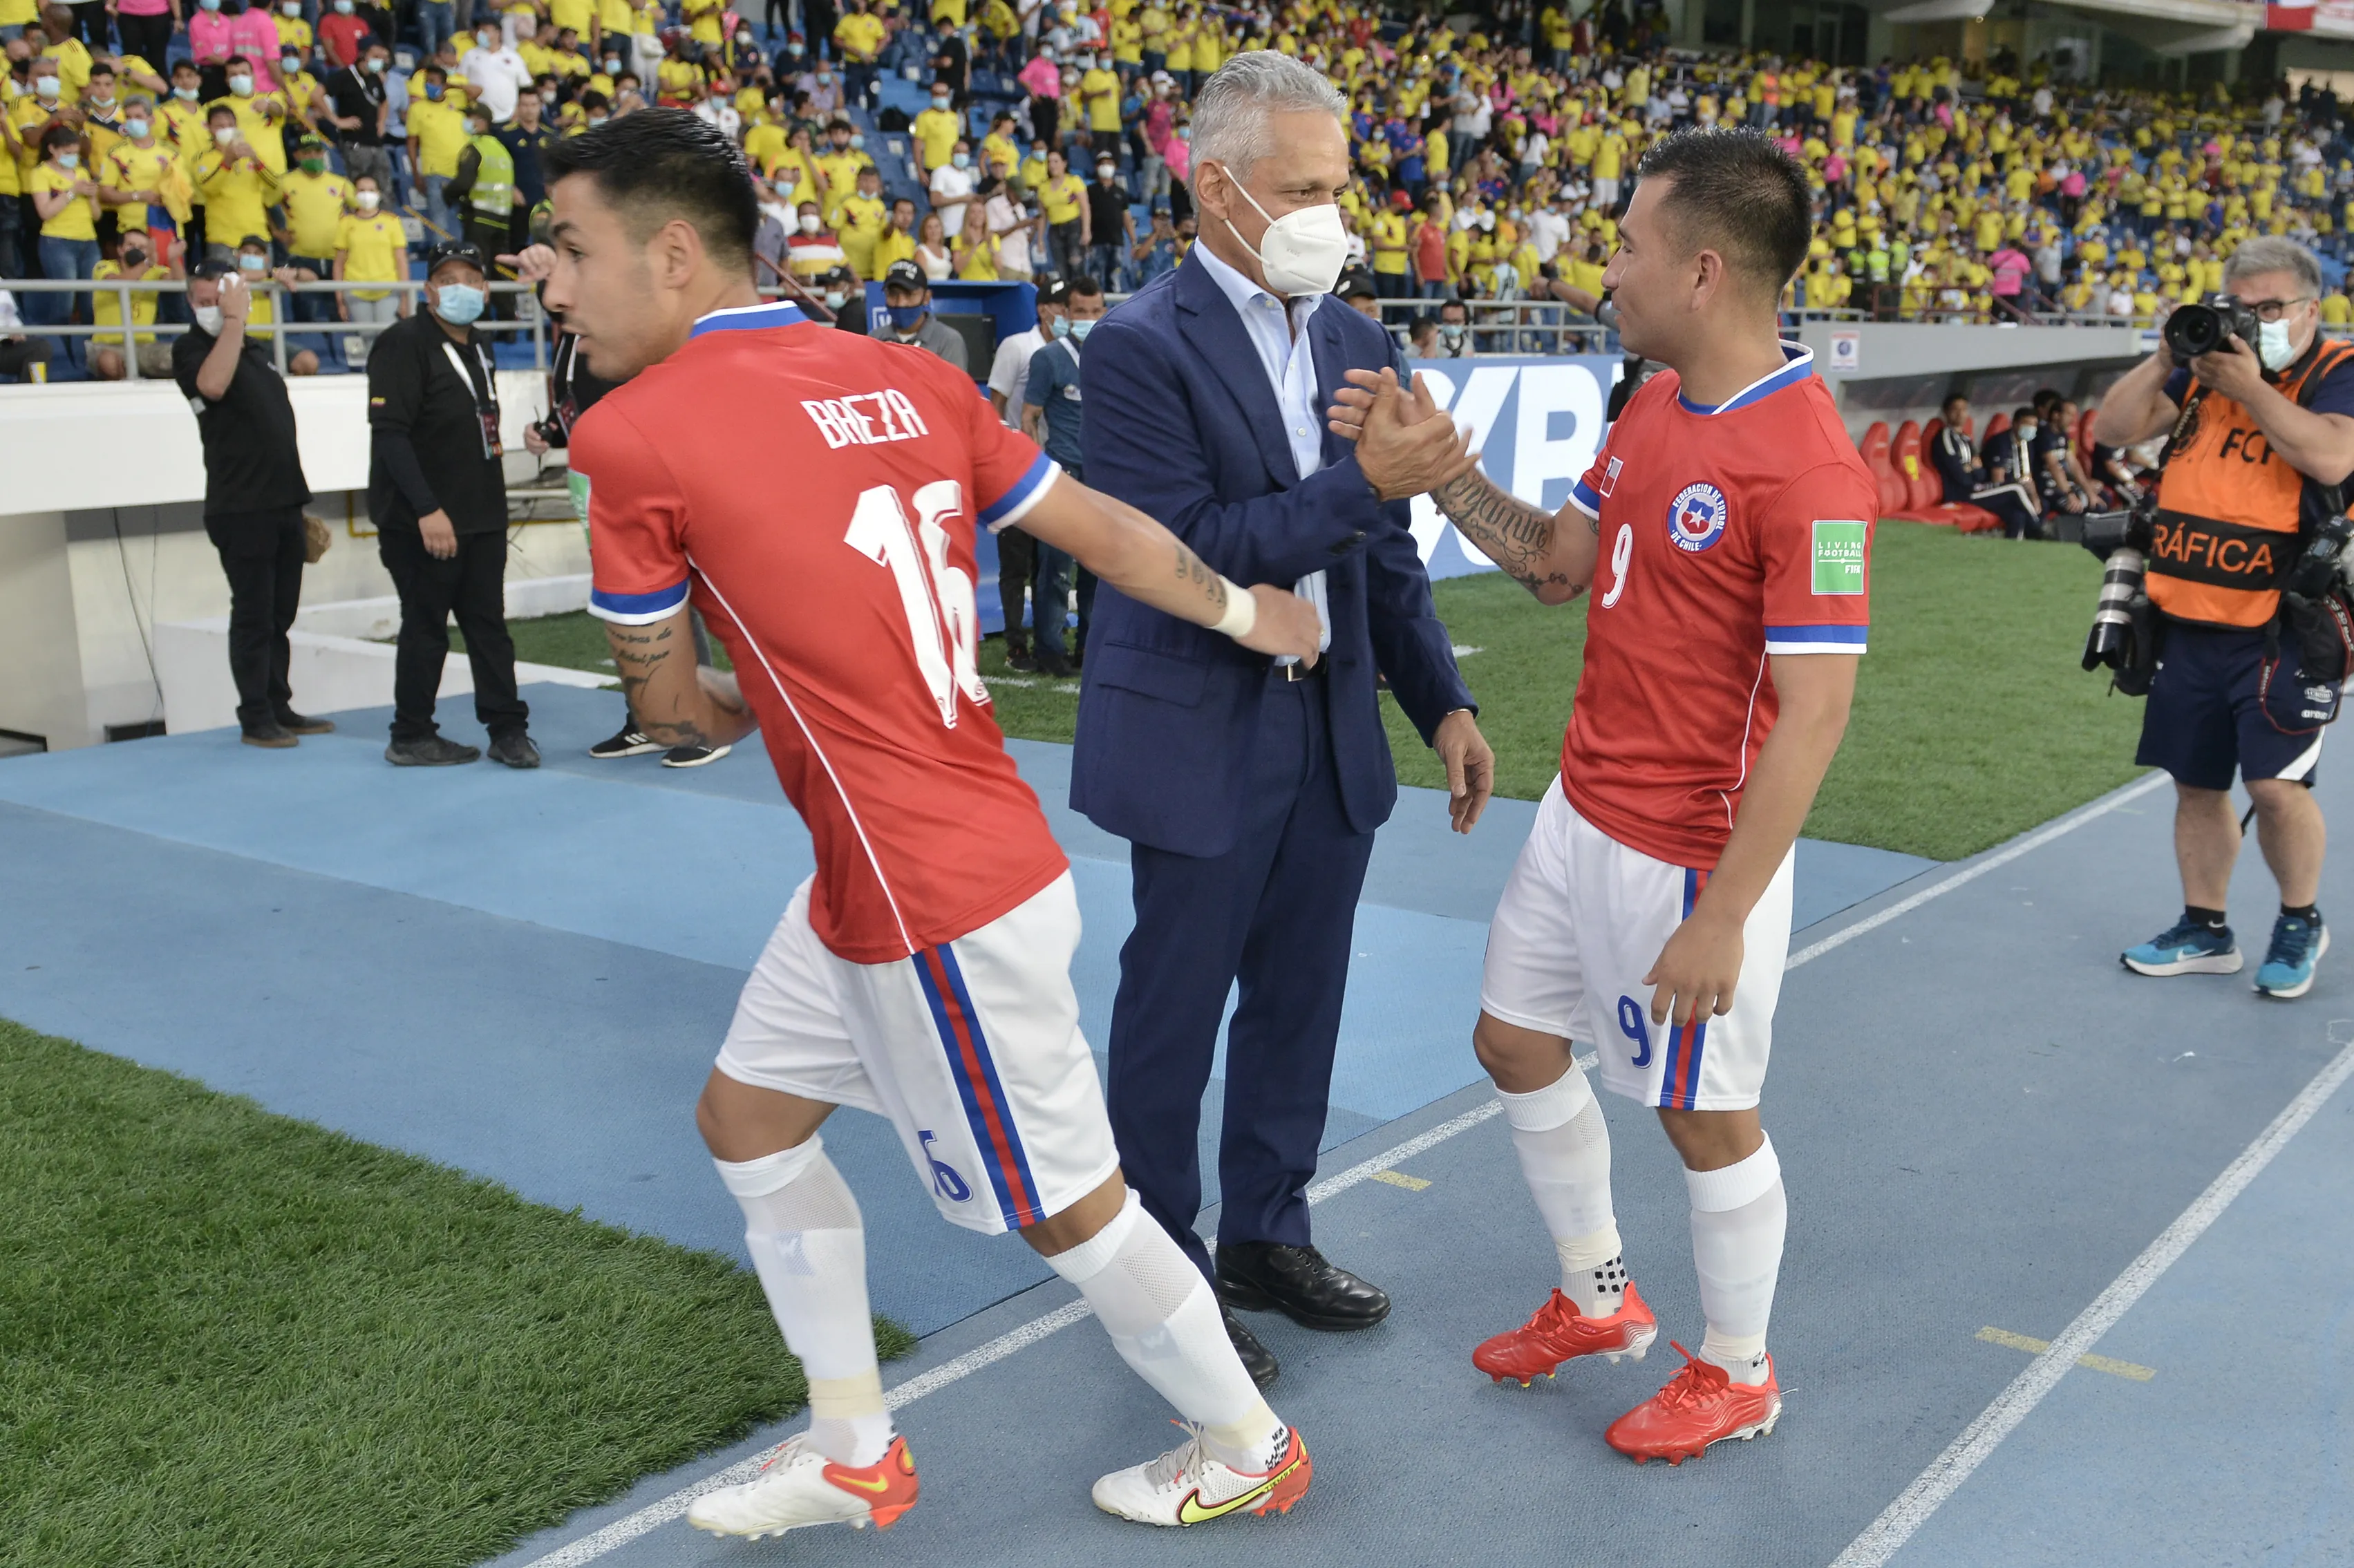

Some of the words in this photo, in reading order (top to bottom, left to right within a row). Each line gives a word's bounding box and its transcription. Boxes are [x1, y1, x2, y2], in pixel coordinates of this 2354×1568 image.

[800, 388, 929, 449] BAEZA
[1672, 483, 1713, 508] FEDERACION
[1712, 489, 1722, 502] DE
[1715, 500, 1726, 530] FUTBOL
[1670, 531, 1682, 543] DE
[1679, 539, 1701, 551] CHILE
[1818, 541, 1862, 549] LIVING
[1818, 549, 1863, 558] FOOTBALL
[2151, 522, 2275, 575] RÁFICA
[1601, 523, 1633, 609] 9
[843, 479, 992, 730] 16
[1617, 994, 1653, 1070] 9
[917, 1128, 973, 1203] 6
